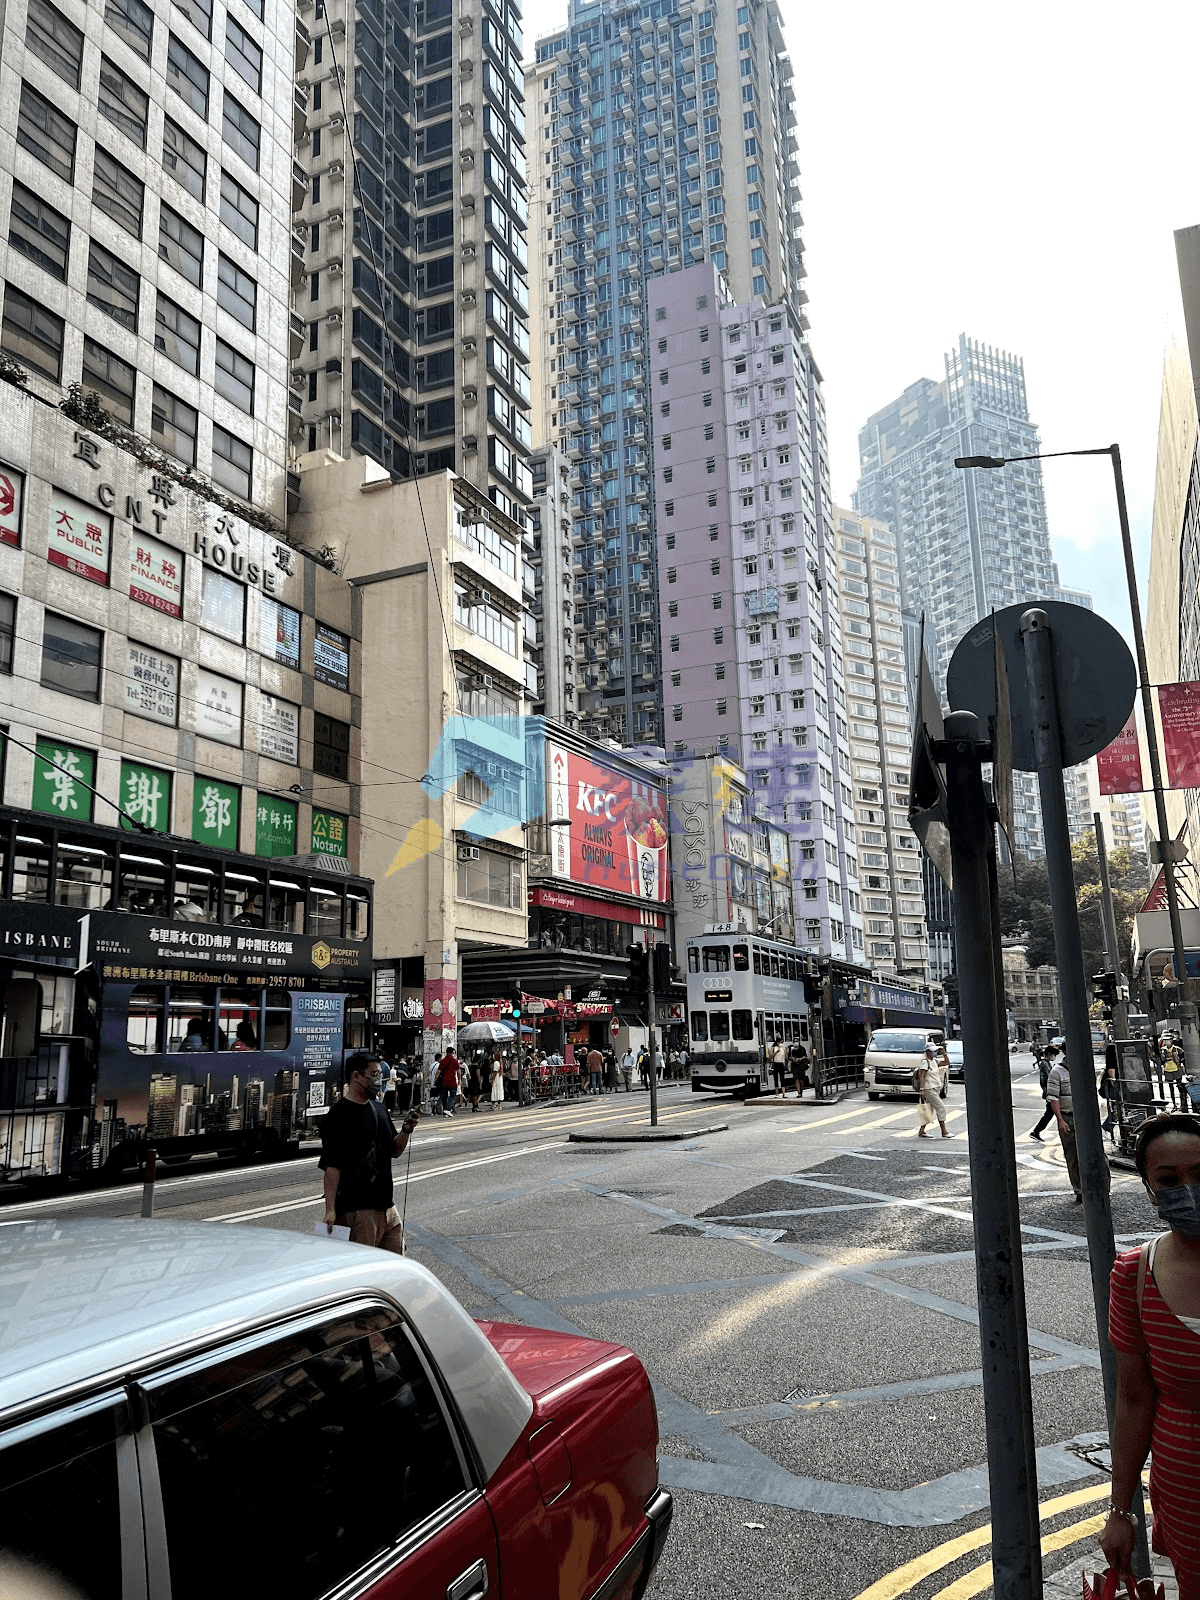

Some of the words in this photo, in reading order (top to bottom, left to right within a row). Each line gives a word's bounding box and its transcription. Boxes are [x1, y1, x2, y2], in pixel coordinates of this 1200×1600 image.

[56, 510, 102, 544] 大眾
[57, 529, 103, 557] PUBLIC
[98, 482, 167, 534] CNT
[194, 532, 276, 593] HOUSE
[136, 547, 176, 580] 財務
[130, 562, 180, 593] FINANCE
[155, 596, 176, 614] 6245
[140, 684, 157, 699] 2527
[139, 698, 157, 712] 2527
[43, 750, 85, 812] 葉
[124, 771, 163, 828] 謝
[199, 786, 231, 838] 鄧
[257, 807, 294, 832] 律師行
[575, 780, 618, 823] KFC
[313, 814, 344, 841] 公證
[584, 823, 613, 848] ALWAYS
[312, 836, 343, 856] Notary
[581, 844, 616, 870] ORIGINAL
[712, 923, 732, 932] 148
[149, 928, 231, 949] 布里斯本CBD南岸
[95, 945, 131, 954] BRISBANE
[331, 948, 360, 957] PROPERTY
[331, 957, 360, 967] AUSTRALIA
[223, 974, 239, 984] One
[288, 977, 305, 988] 8701
[298, 998, 341, 1010] BRISBANE
[378, 1013, 392, 1022] 120
